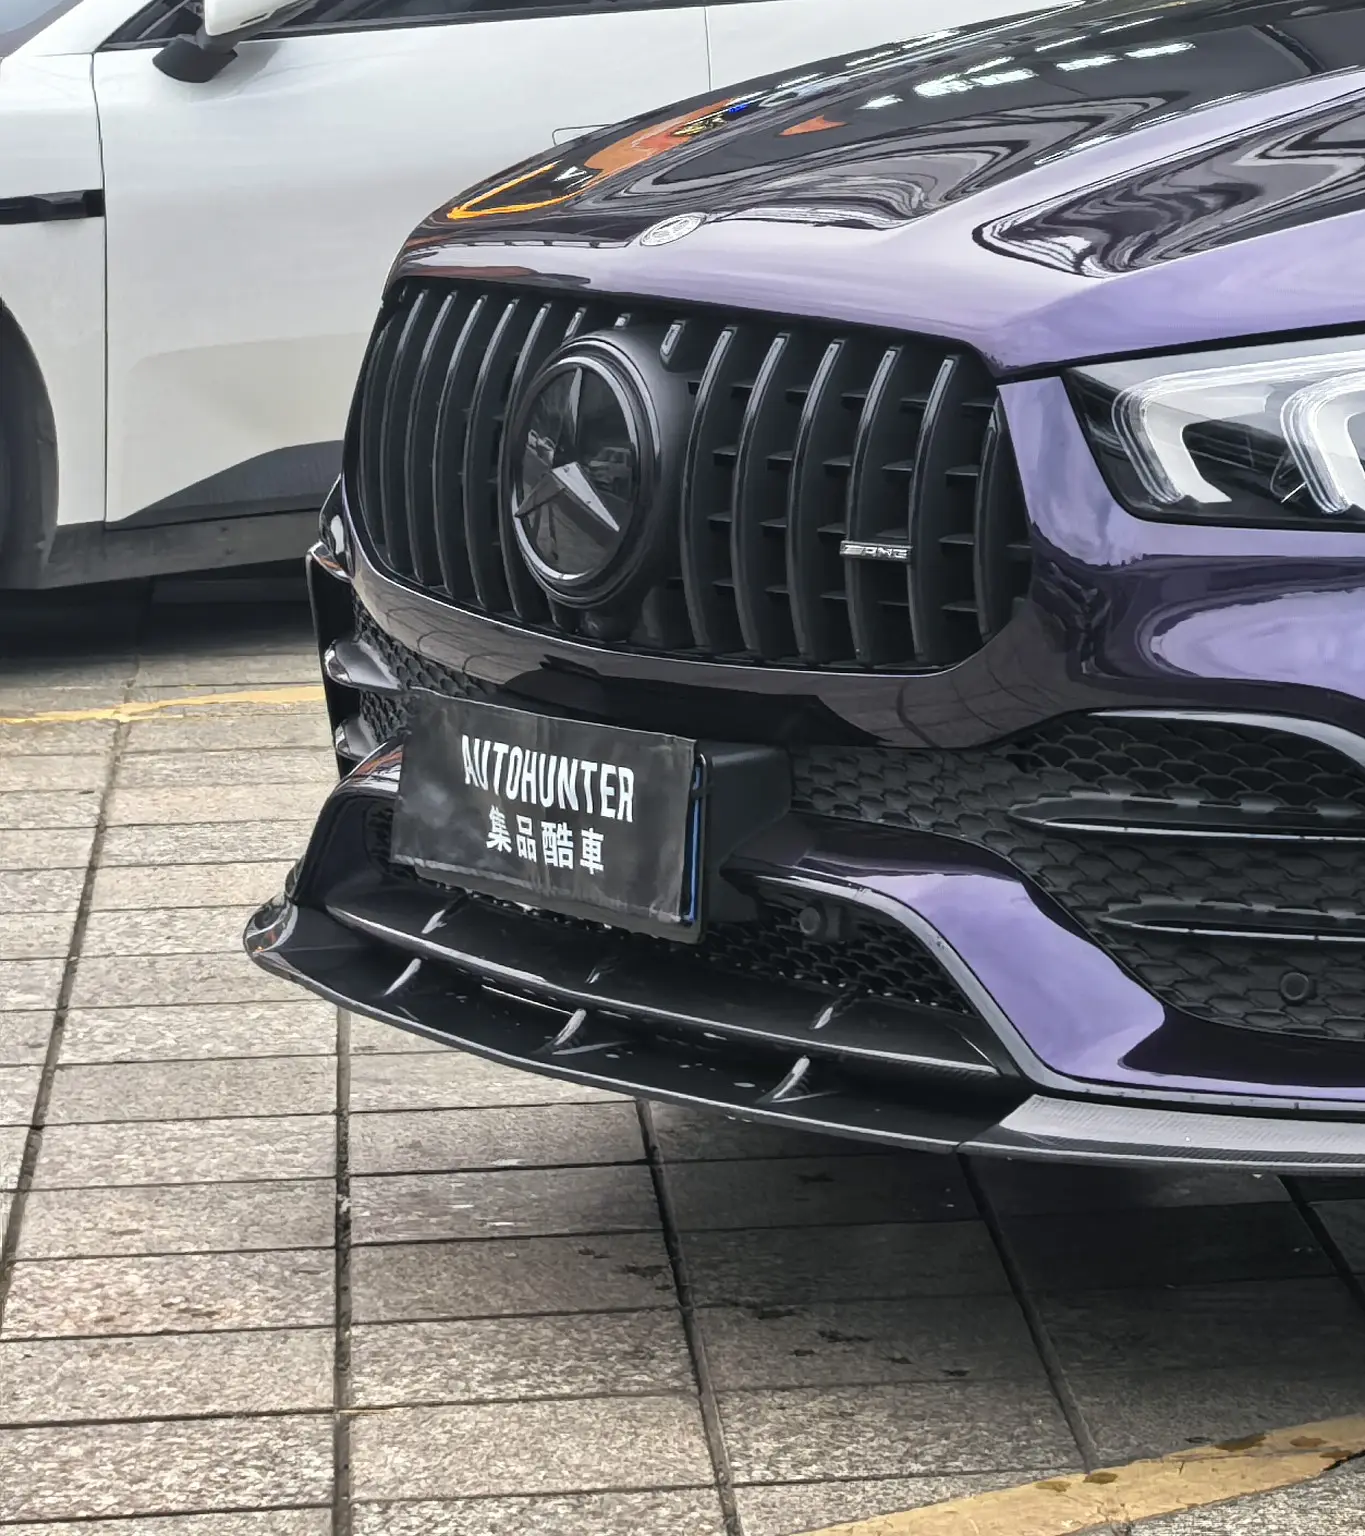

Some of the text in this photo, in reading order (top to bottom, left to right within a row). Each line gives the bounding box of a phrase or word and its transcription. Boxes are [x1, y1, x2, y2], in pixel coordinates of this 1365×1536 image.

[462, 735, 634, 823] AUTOHUNTER
[486, 805, 604, 875] 集品酷車
